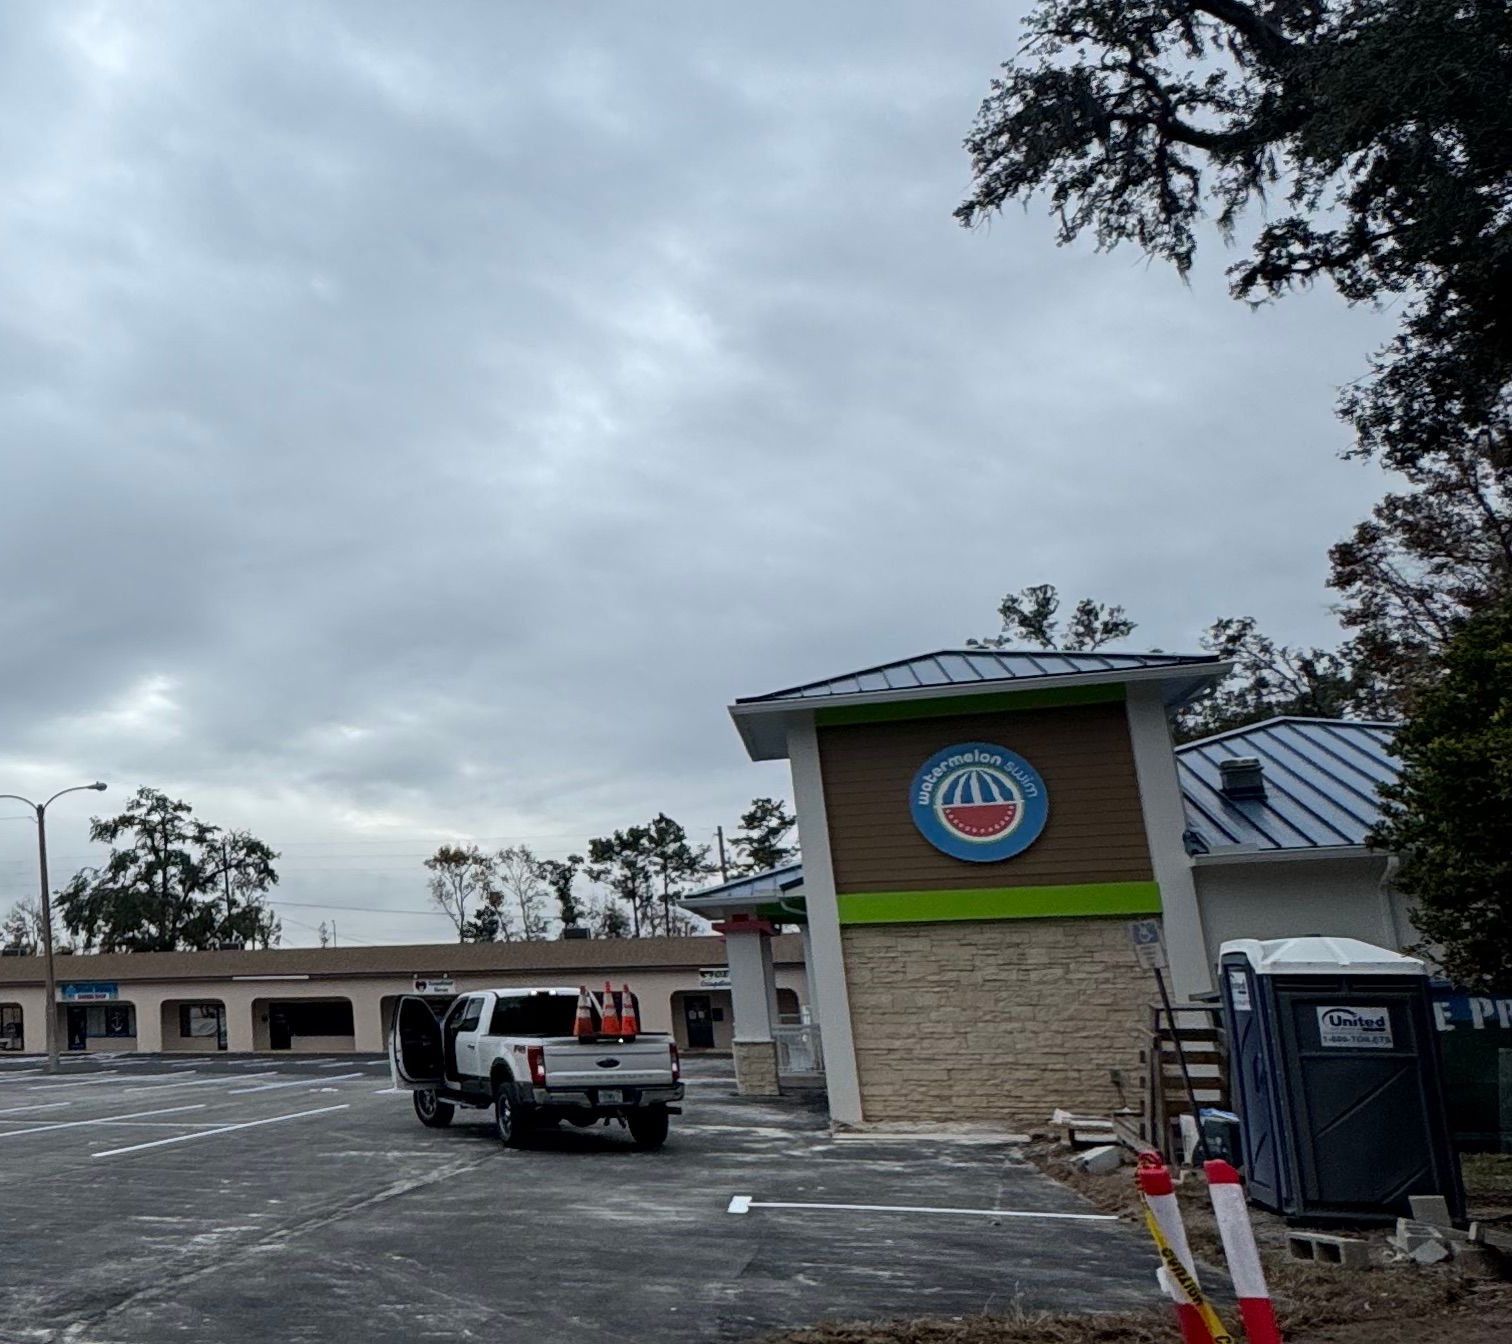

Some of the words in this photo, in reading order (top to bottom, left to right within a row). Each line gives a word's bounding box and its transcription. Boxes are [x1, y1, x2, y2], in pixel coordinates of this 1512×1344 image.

[918, 748, 1002, 806] watermelon
[1003, 761, 1039, 799] swim
[1329, 1014, 1386, 1027] United
